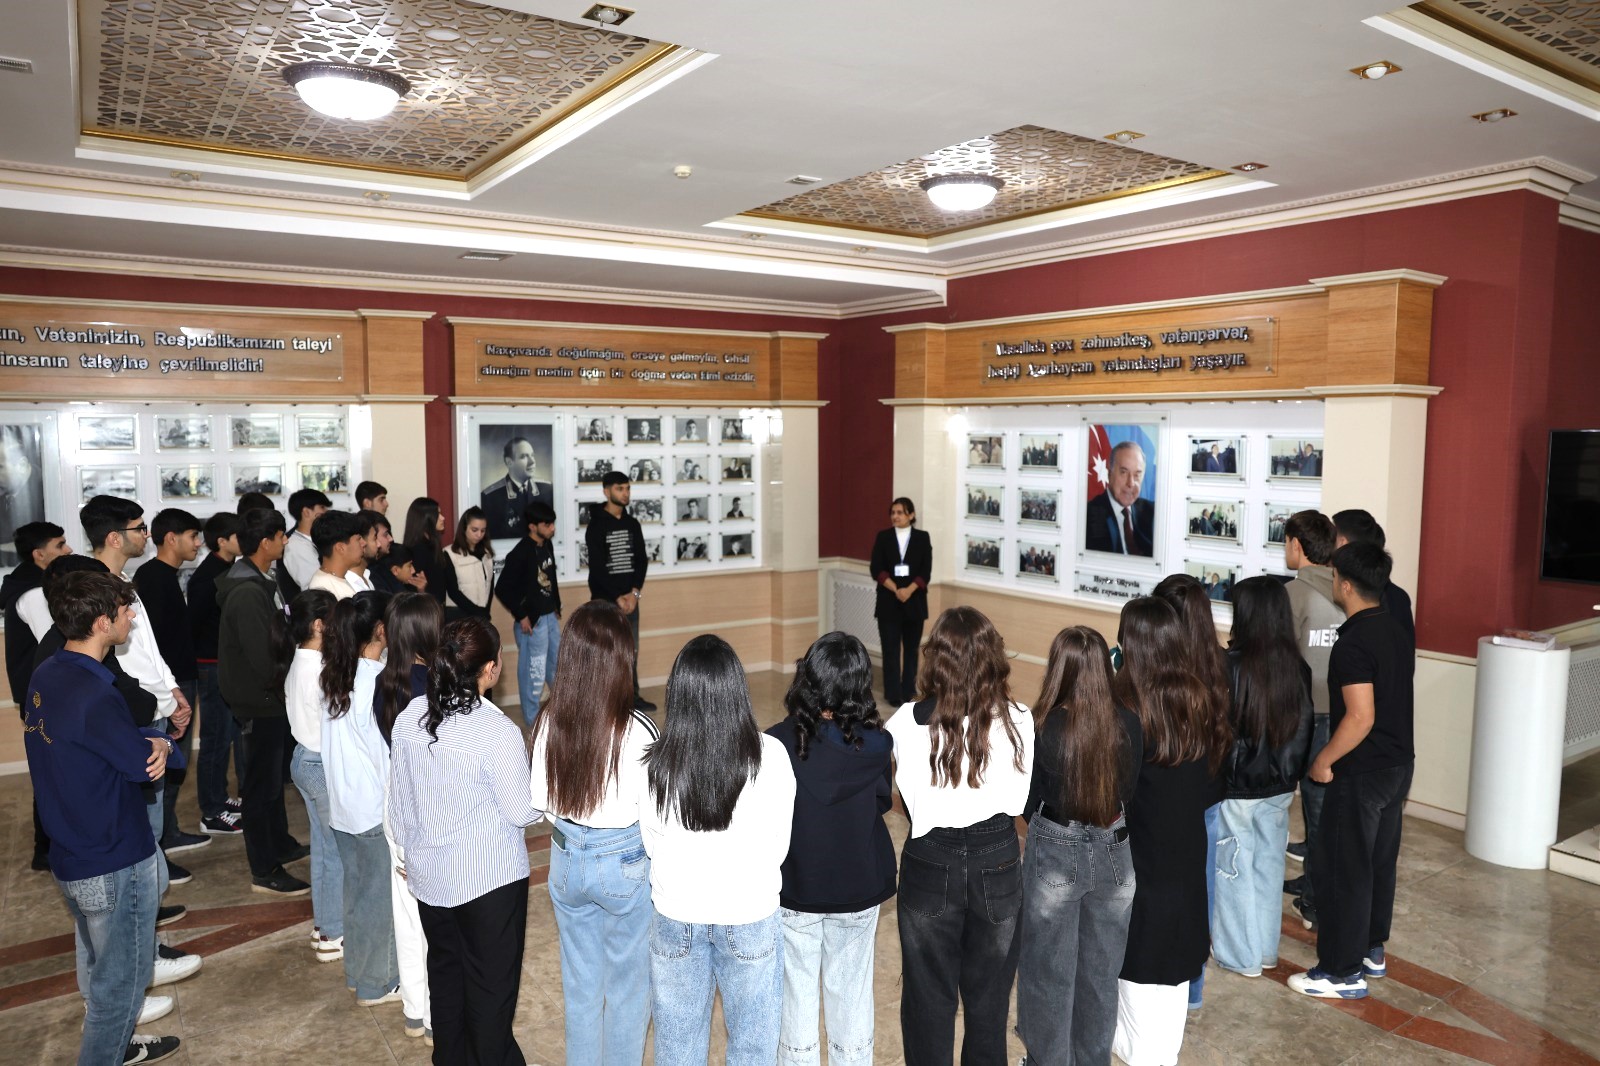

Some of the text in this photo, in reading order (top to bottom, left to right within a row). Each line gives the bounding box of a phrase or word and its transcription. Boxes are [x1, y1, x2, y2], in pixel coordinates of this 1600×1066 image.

[0, 326, 333, 353] ın, Vətənimizin, Respublikamızın taleyi
[1050, 339, 1074, 354] çox
[1160, 326, 1248, 344] vətənpərvər,
[0, 352, 264, 374] insanın taleyinə çevrilməlidir!
[579, 366, 606, 380] üçün
[1026, 360, 1095, 377] Azərbaycan
